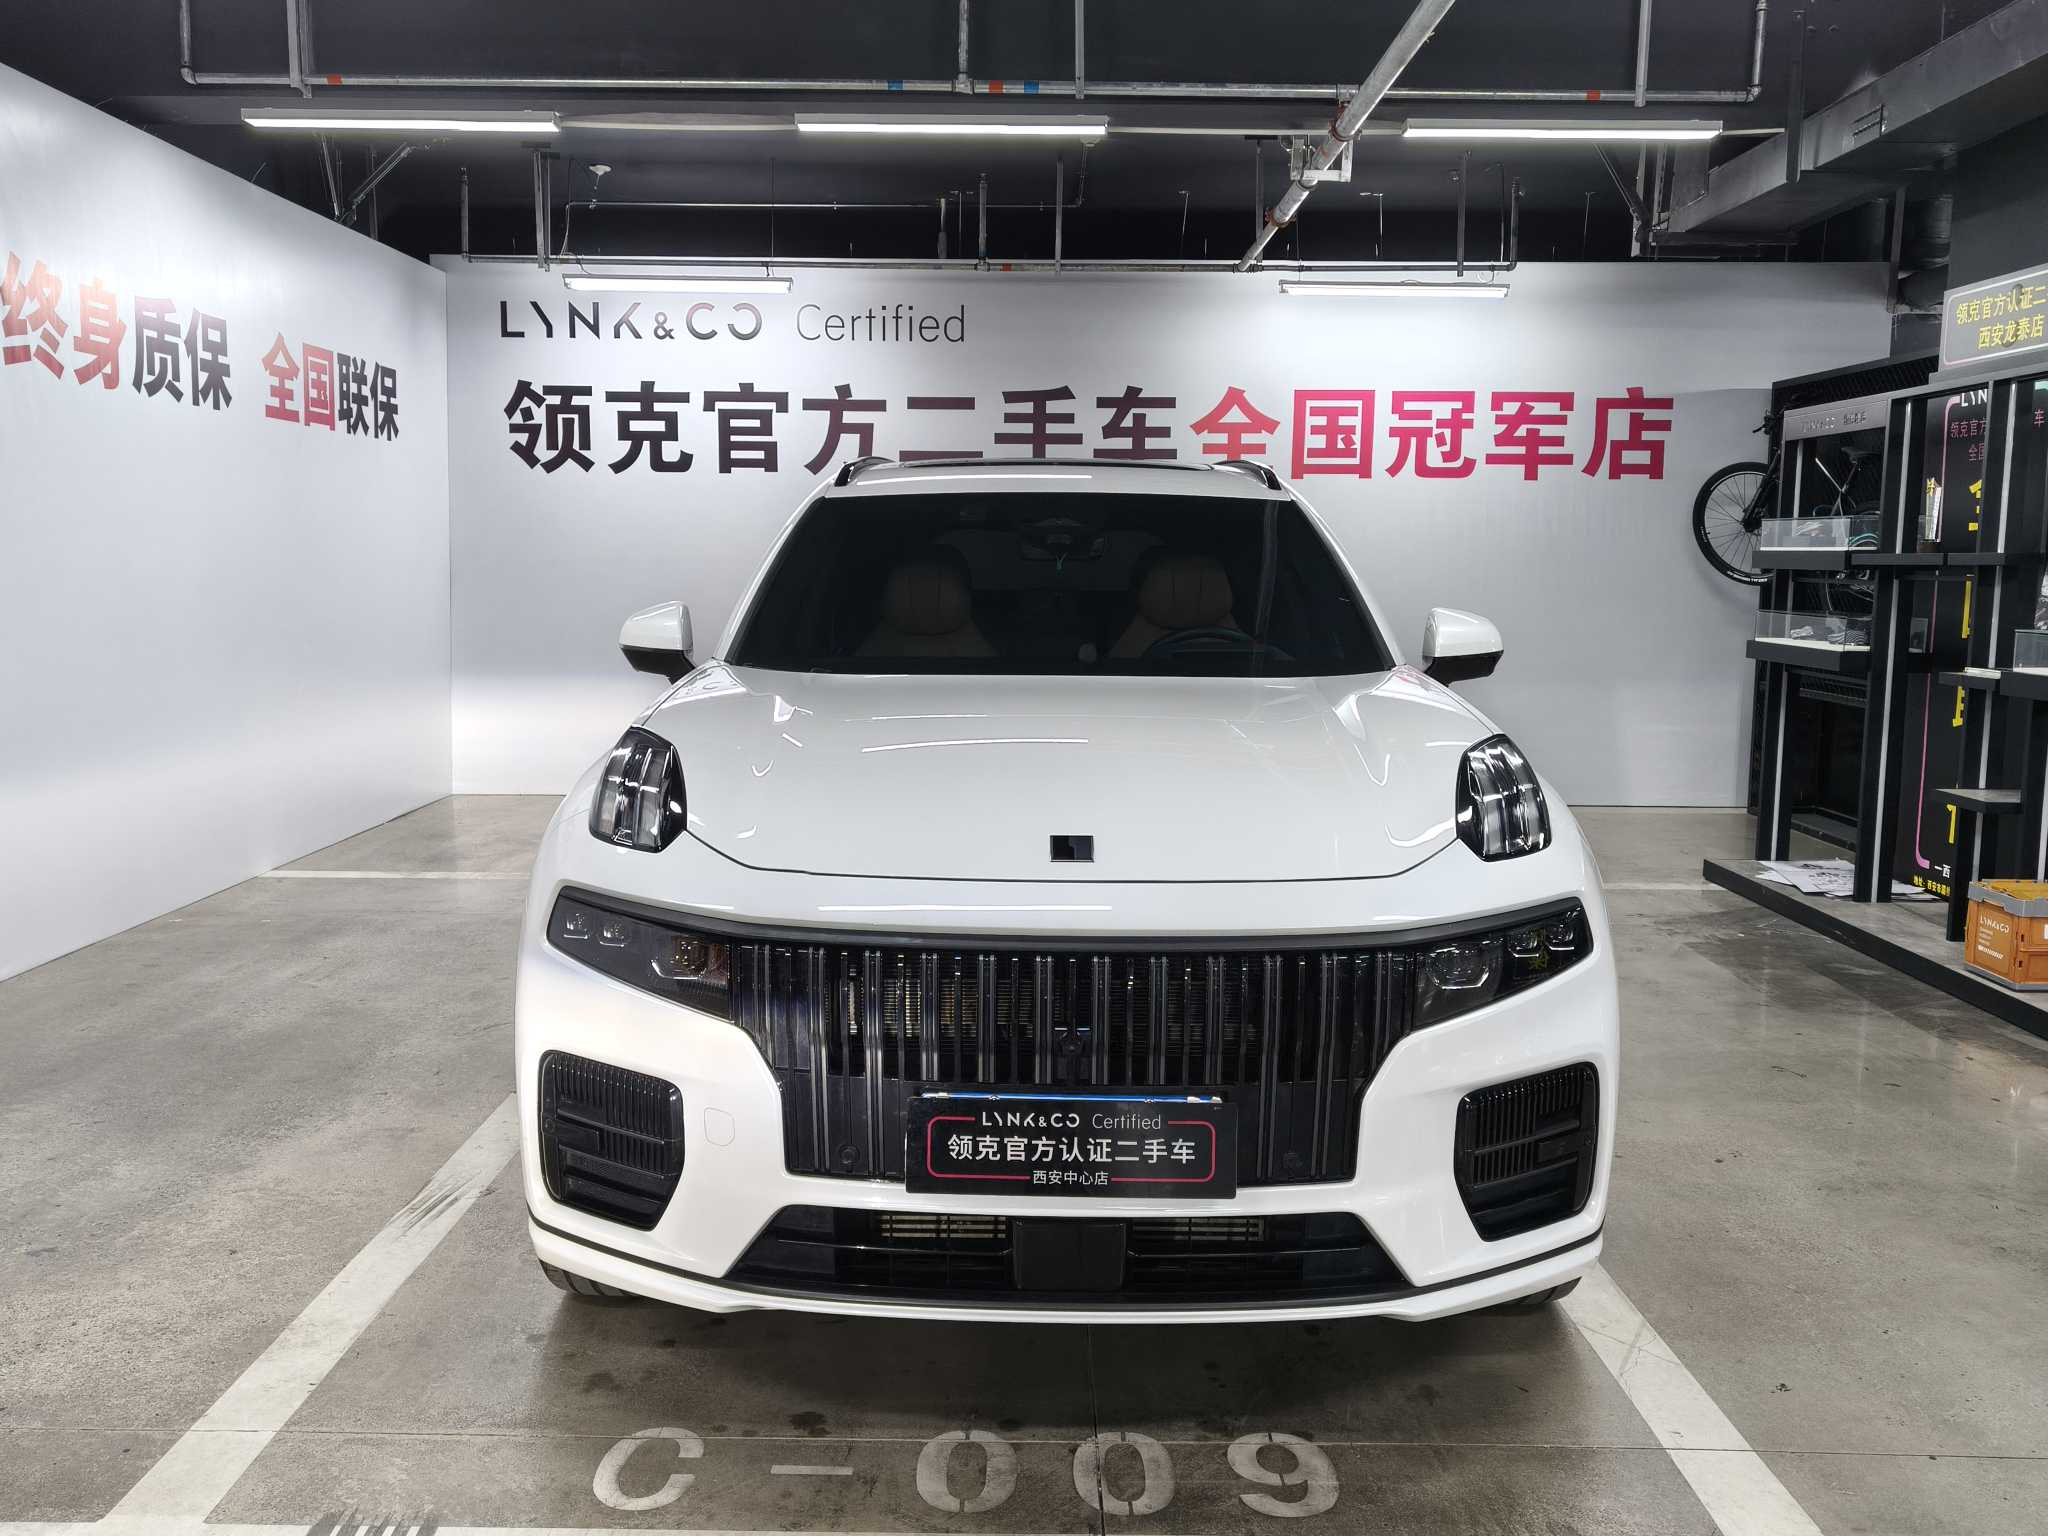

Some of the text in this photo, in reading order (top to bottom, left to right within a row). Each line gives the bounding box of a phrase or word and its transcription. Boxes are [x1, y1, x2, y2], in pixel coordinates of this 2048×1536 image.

[1956, 286, 2048, 325] 领克官方认证二
[797, 304, 966, 343] Certified
[1, 250, 400, 442] 终身质保 全国联保
[503, 379, 1675, 481] 领克官方二手车全国冠军店
[2034, 408, 2045, 427] 车
[1092, 1113, 1161, 1130] Certified
[947, 1134, 1196, 1165] 领克官方认证二手车
[1032, 1170, 1109, 1186] 西安中心店
